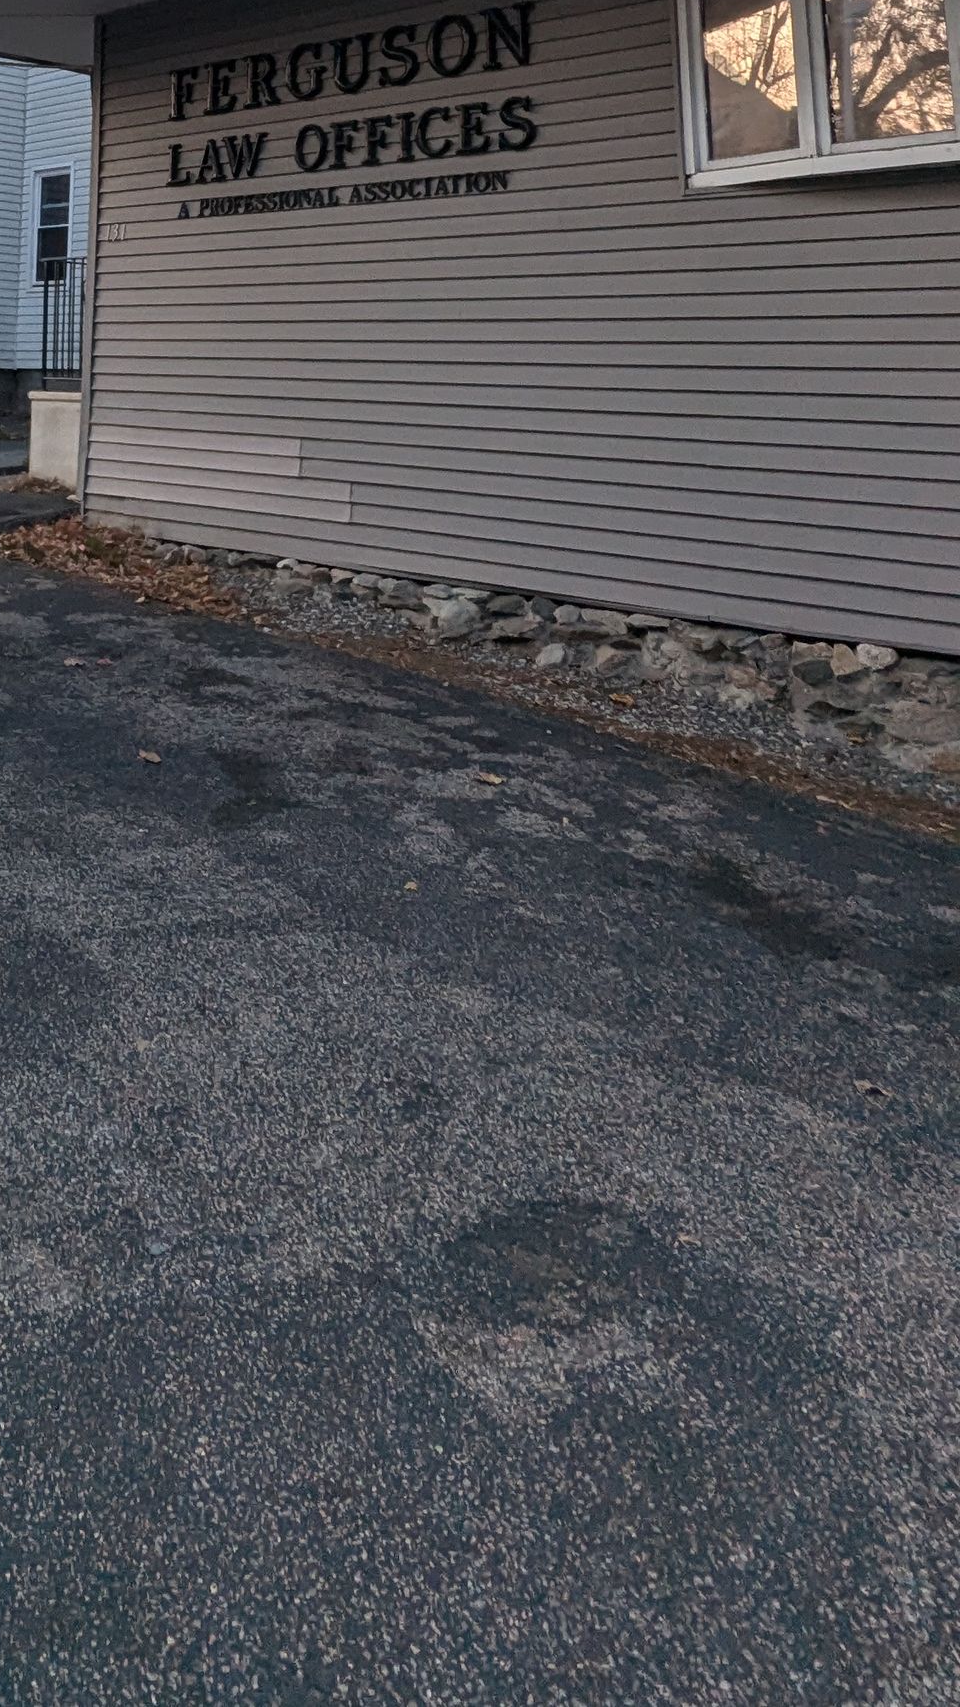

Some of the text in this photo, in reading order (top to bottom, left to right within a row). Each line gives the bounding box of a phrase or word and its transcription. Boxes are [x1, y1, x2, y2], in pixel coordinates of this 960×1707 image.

[168, 1, 536, 122] FERGUSON
[166, 96, 538, 187] LAW OFFICES
[178, 170, 511, 219] A PROFESSIONAL ASSOCIATION
[106, 223, 127, 242] 131
